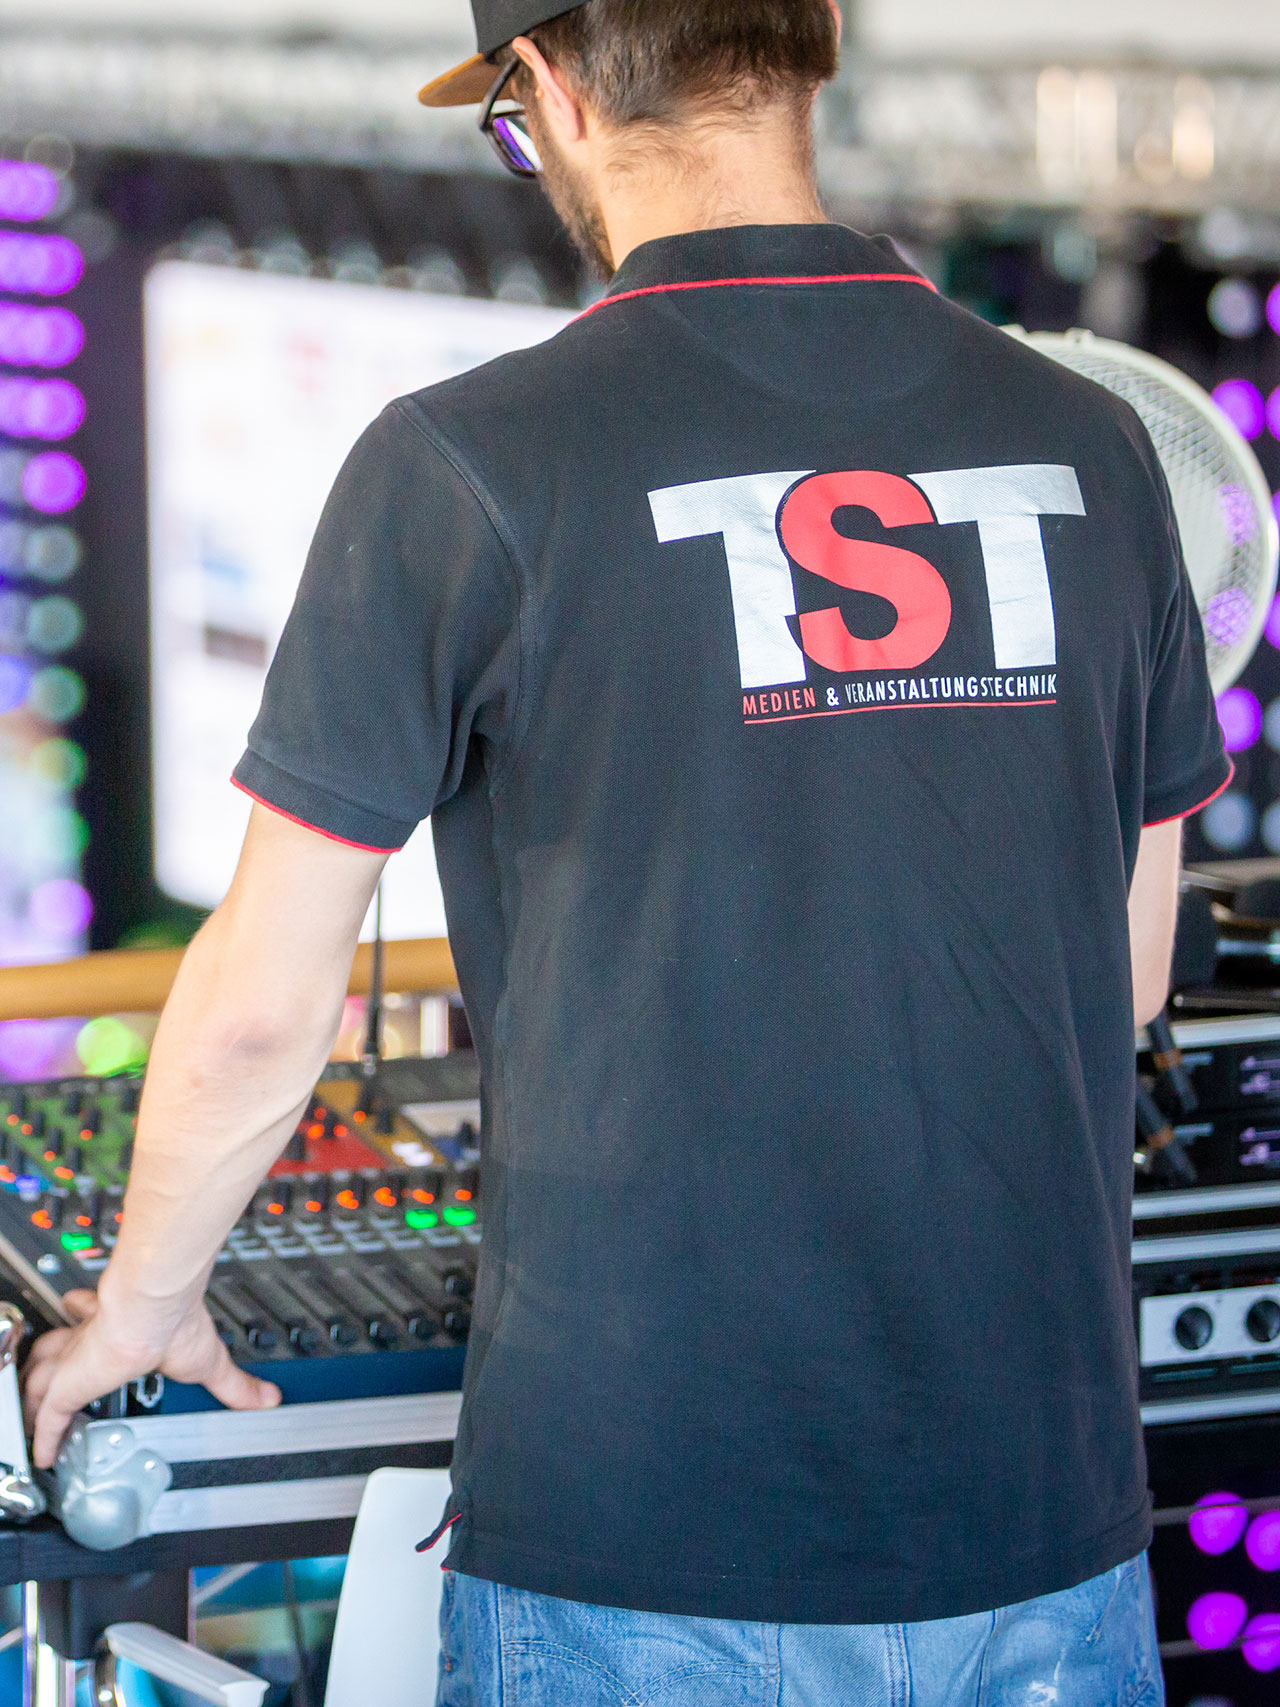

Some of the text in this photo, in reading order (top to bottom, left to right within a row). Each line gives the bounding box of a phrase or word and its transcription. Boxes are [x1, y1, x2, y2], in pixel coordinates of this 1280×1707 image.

[647, 464, 1086, 689] TST
[742, 674, 1057, 715] MEDIEN & VERANSTALTUNGSTECHNIK
